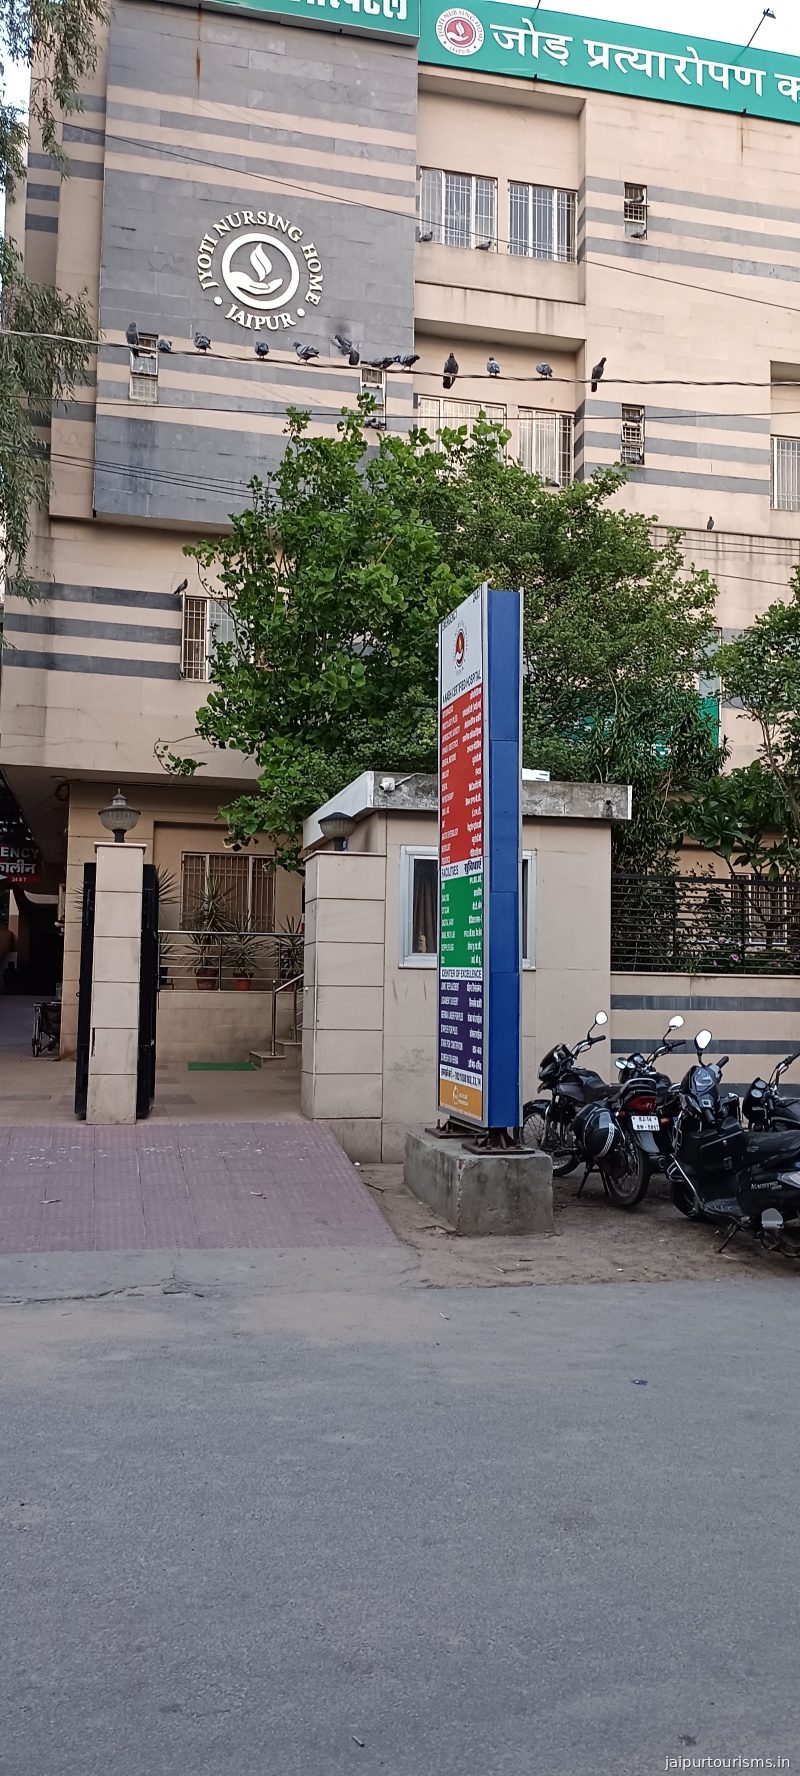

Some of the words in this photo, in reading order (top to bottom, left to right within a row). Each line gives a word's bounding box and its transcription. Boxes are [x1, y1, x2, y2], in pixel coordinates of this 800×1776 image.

[490, 18, 574, 67] जोड़
[584, 39, 767, 97] प्रत्यारोपण
[196, 233, 219, 291] JYOTI
[212, 210, 304, 243] NURSING
[301, 242, 324, 306] HOME
[224, 303, 297, 331] JAIPUR
[442, 969, 455, 978] CENTER
[456, 969, 461, 978] OF
[461, 969, 482, 979] EXCELLENCE
